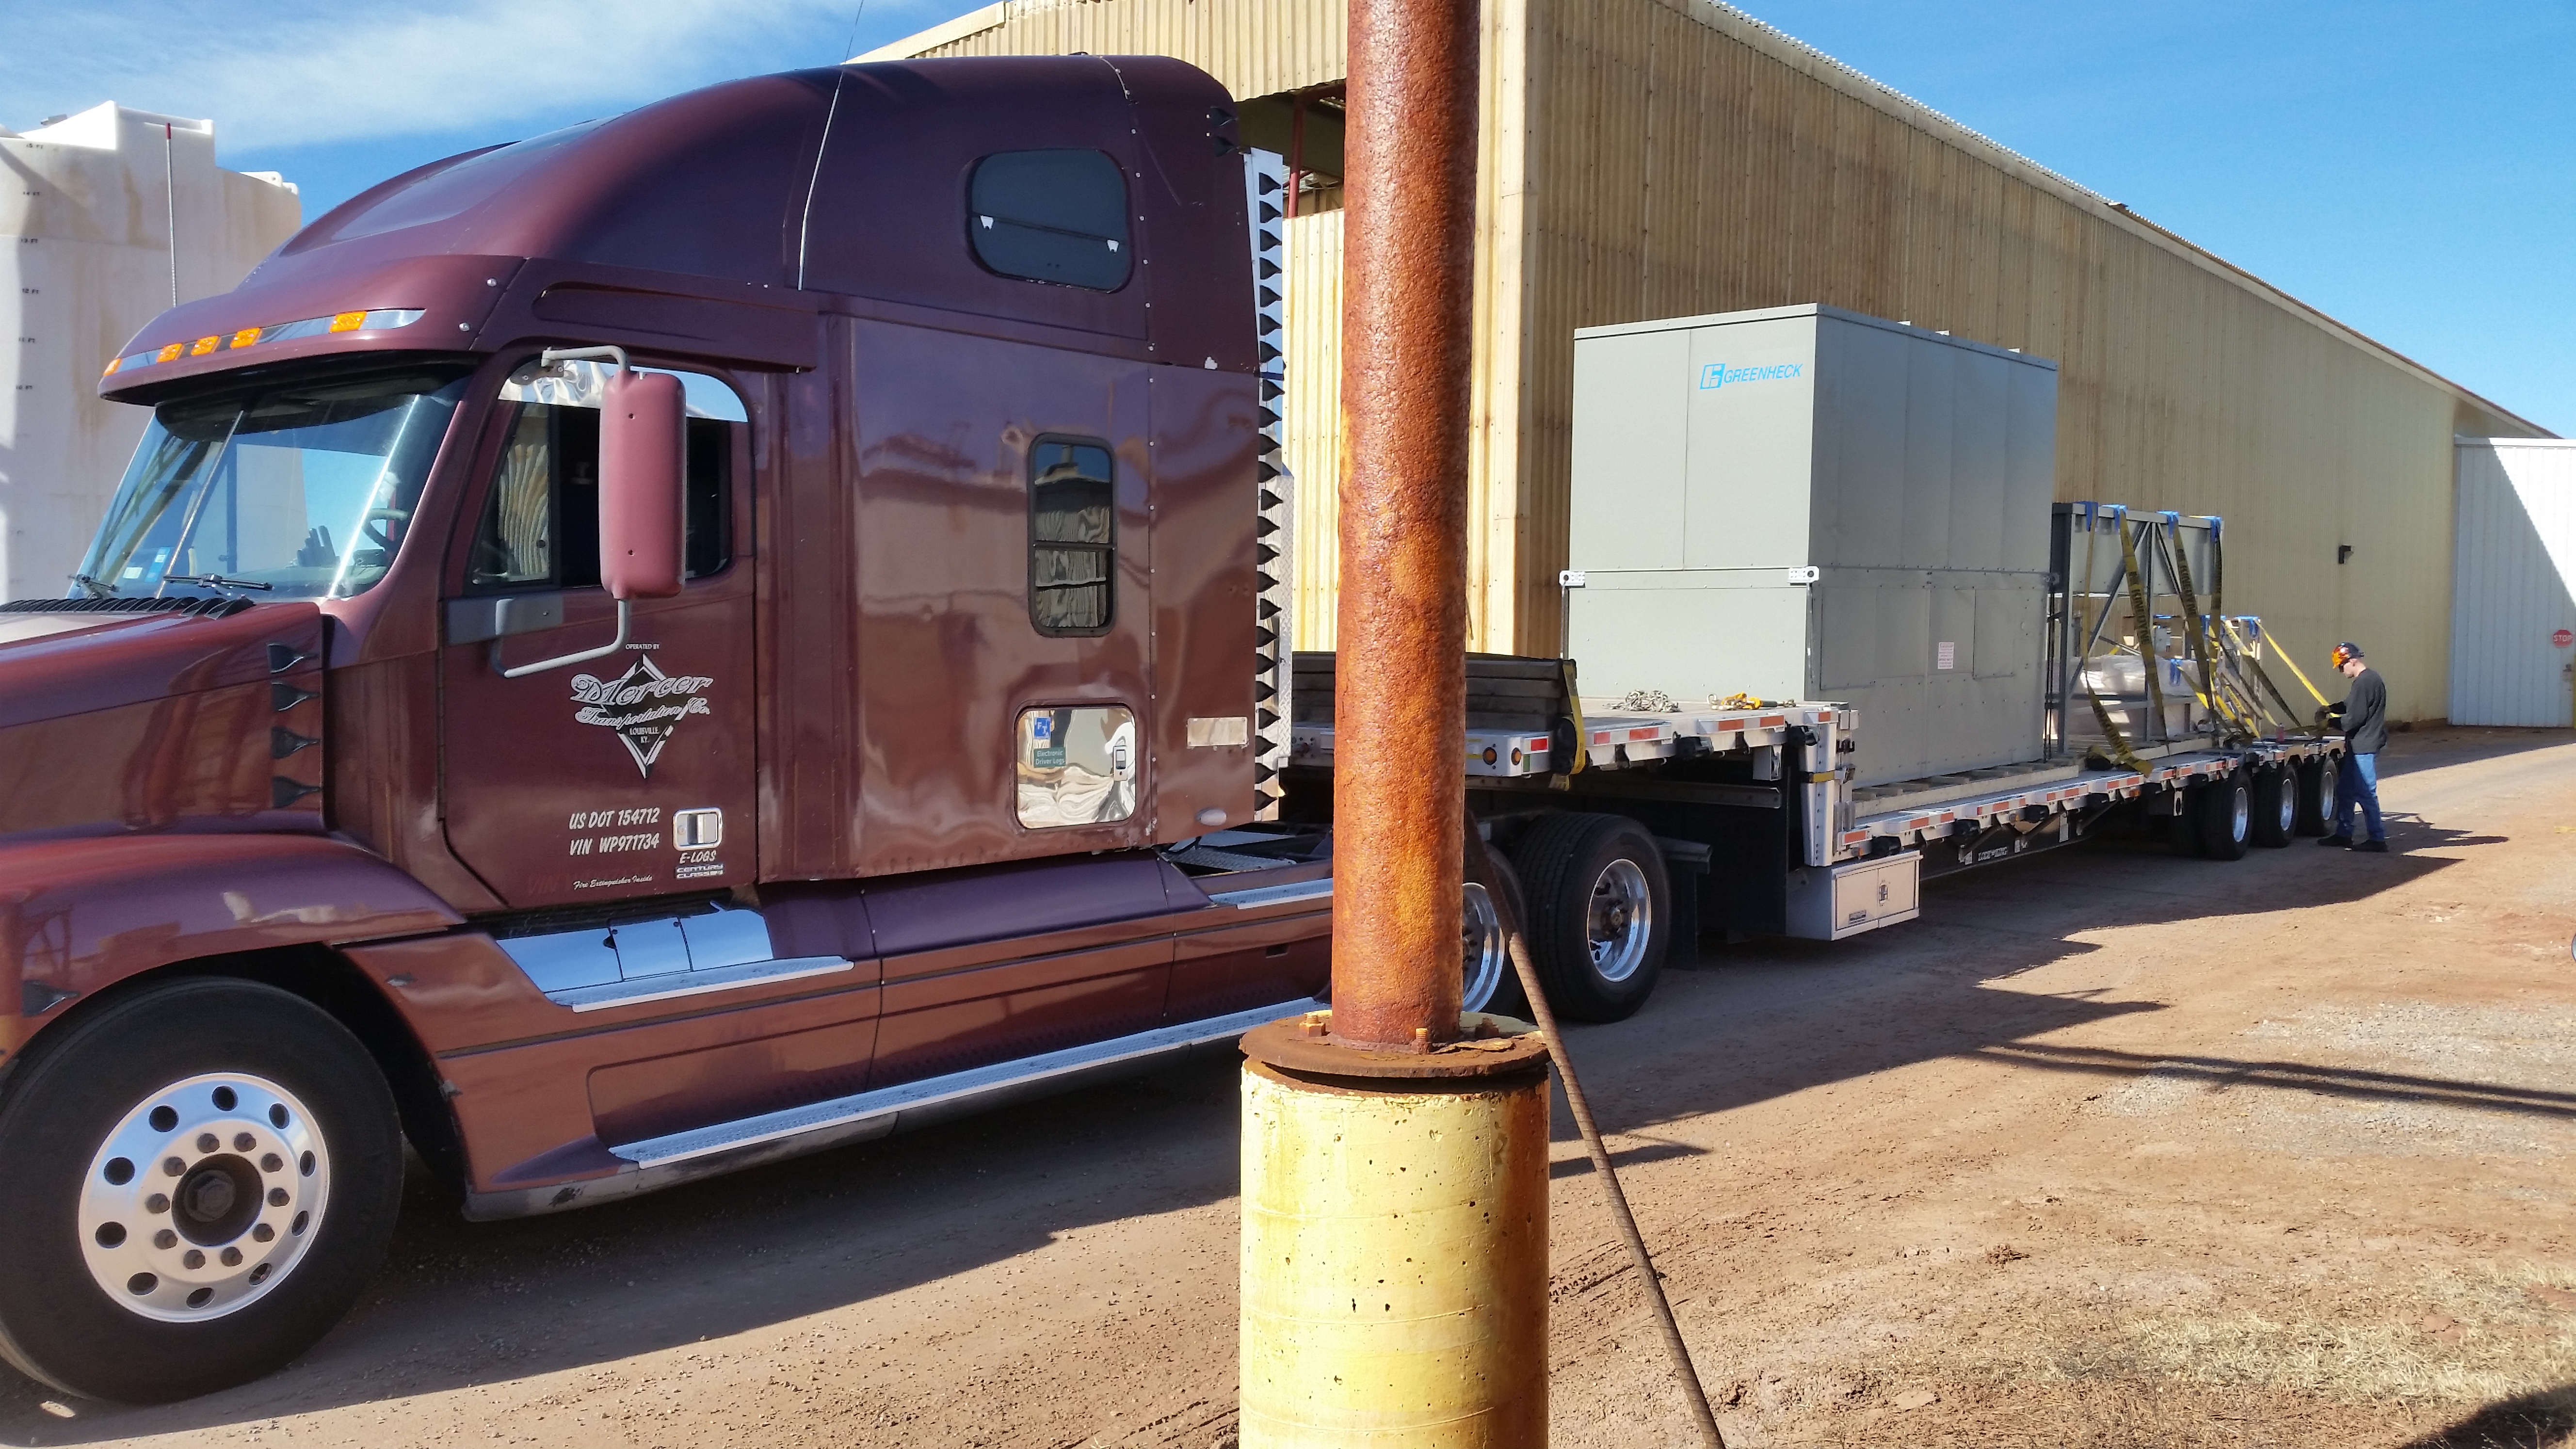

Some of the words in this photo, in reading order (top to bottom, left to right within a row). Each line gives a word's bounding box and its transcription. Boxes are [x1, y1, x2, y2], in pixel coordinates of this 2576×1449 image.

[1724, 363, 1803, 384] GREENHECK
[570, 674, 714, 706] Mercer
[569, 812, 587, 830] US
[588, 810, 615, 829] DOT
[617, 807, 660, 827] 154712
[570, 837, 593, 856] VIN
[599, 832, 660, 853] WP971734
[679, 850, 717, 864] E-LOGS
[573, 880, 589, 890] Fire
[632, 874, 653, 883] Inside
